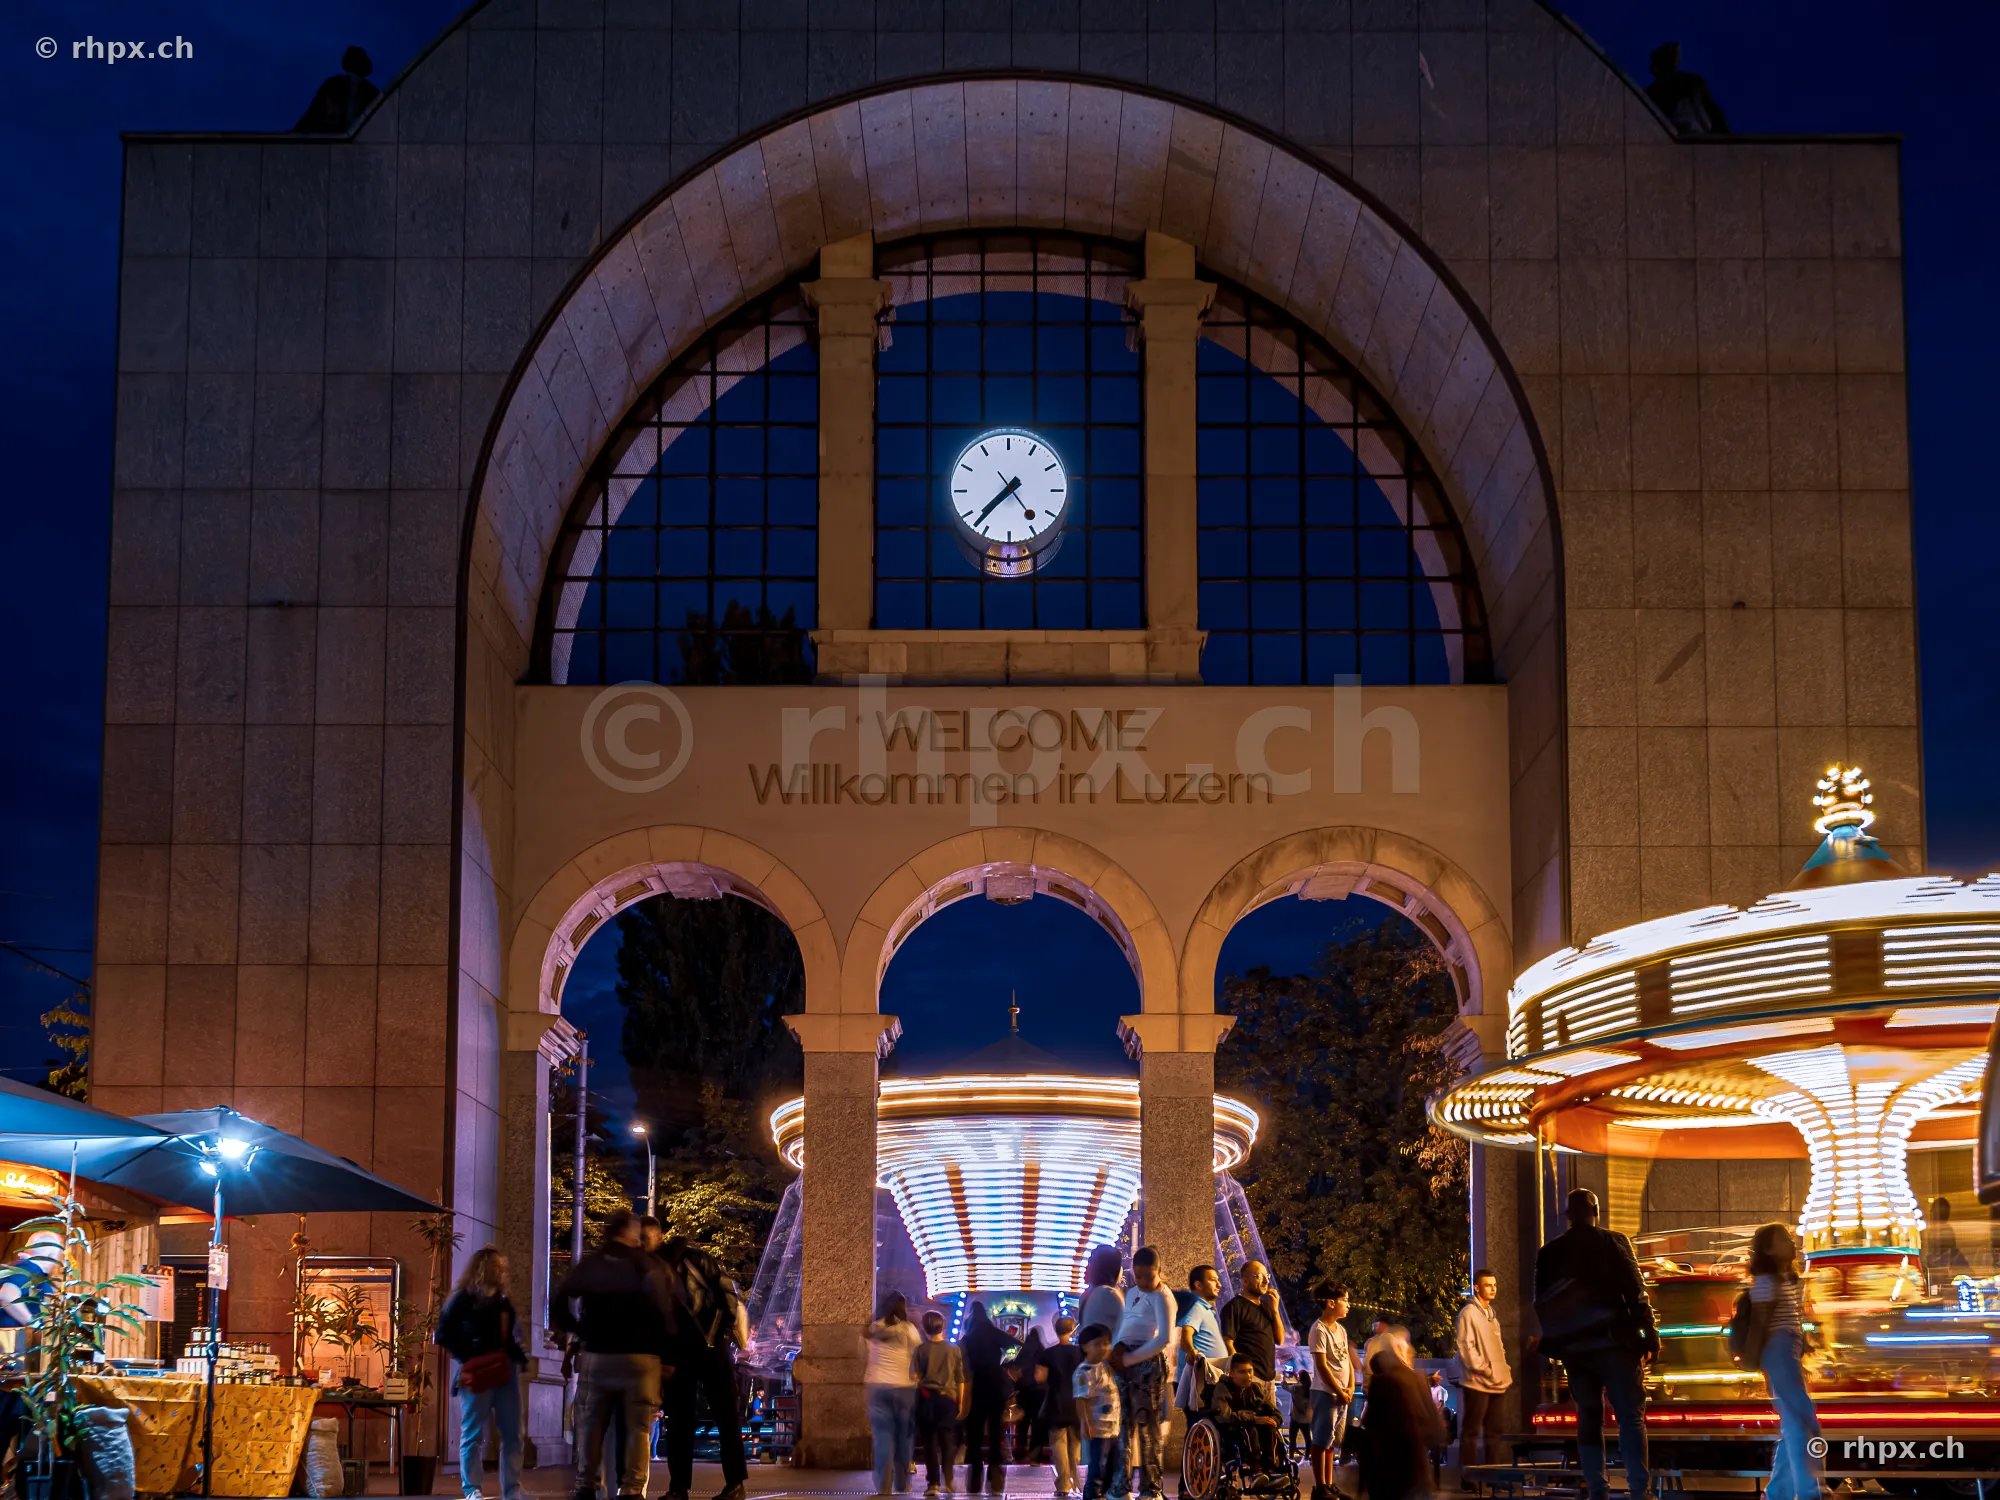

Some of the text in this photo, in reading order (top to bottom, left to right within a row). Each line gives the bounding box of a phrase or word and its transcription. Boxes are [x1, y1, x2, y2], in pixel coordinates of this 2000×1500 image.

[875, 709, 1148, 752] WELCOME
[748, 762, 1274, 805] Willkommen in Luzern
